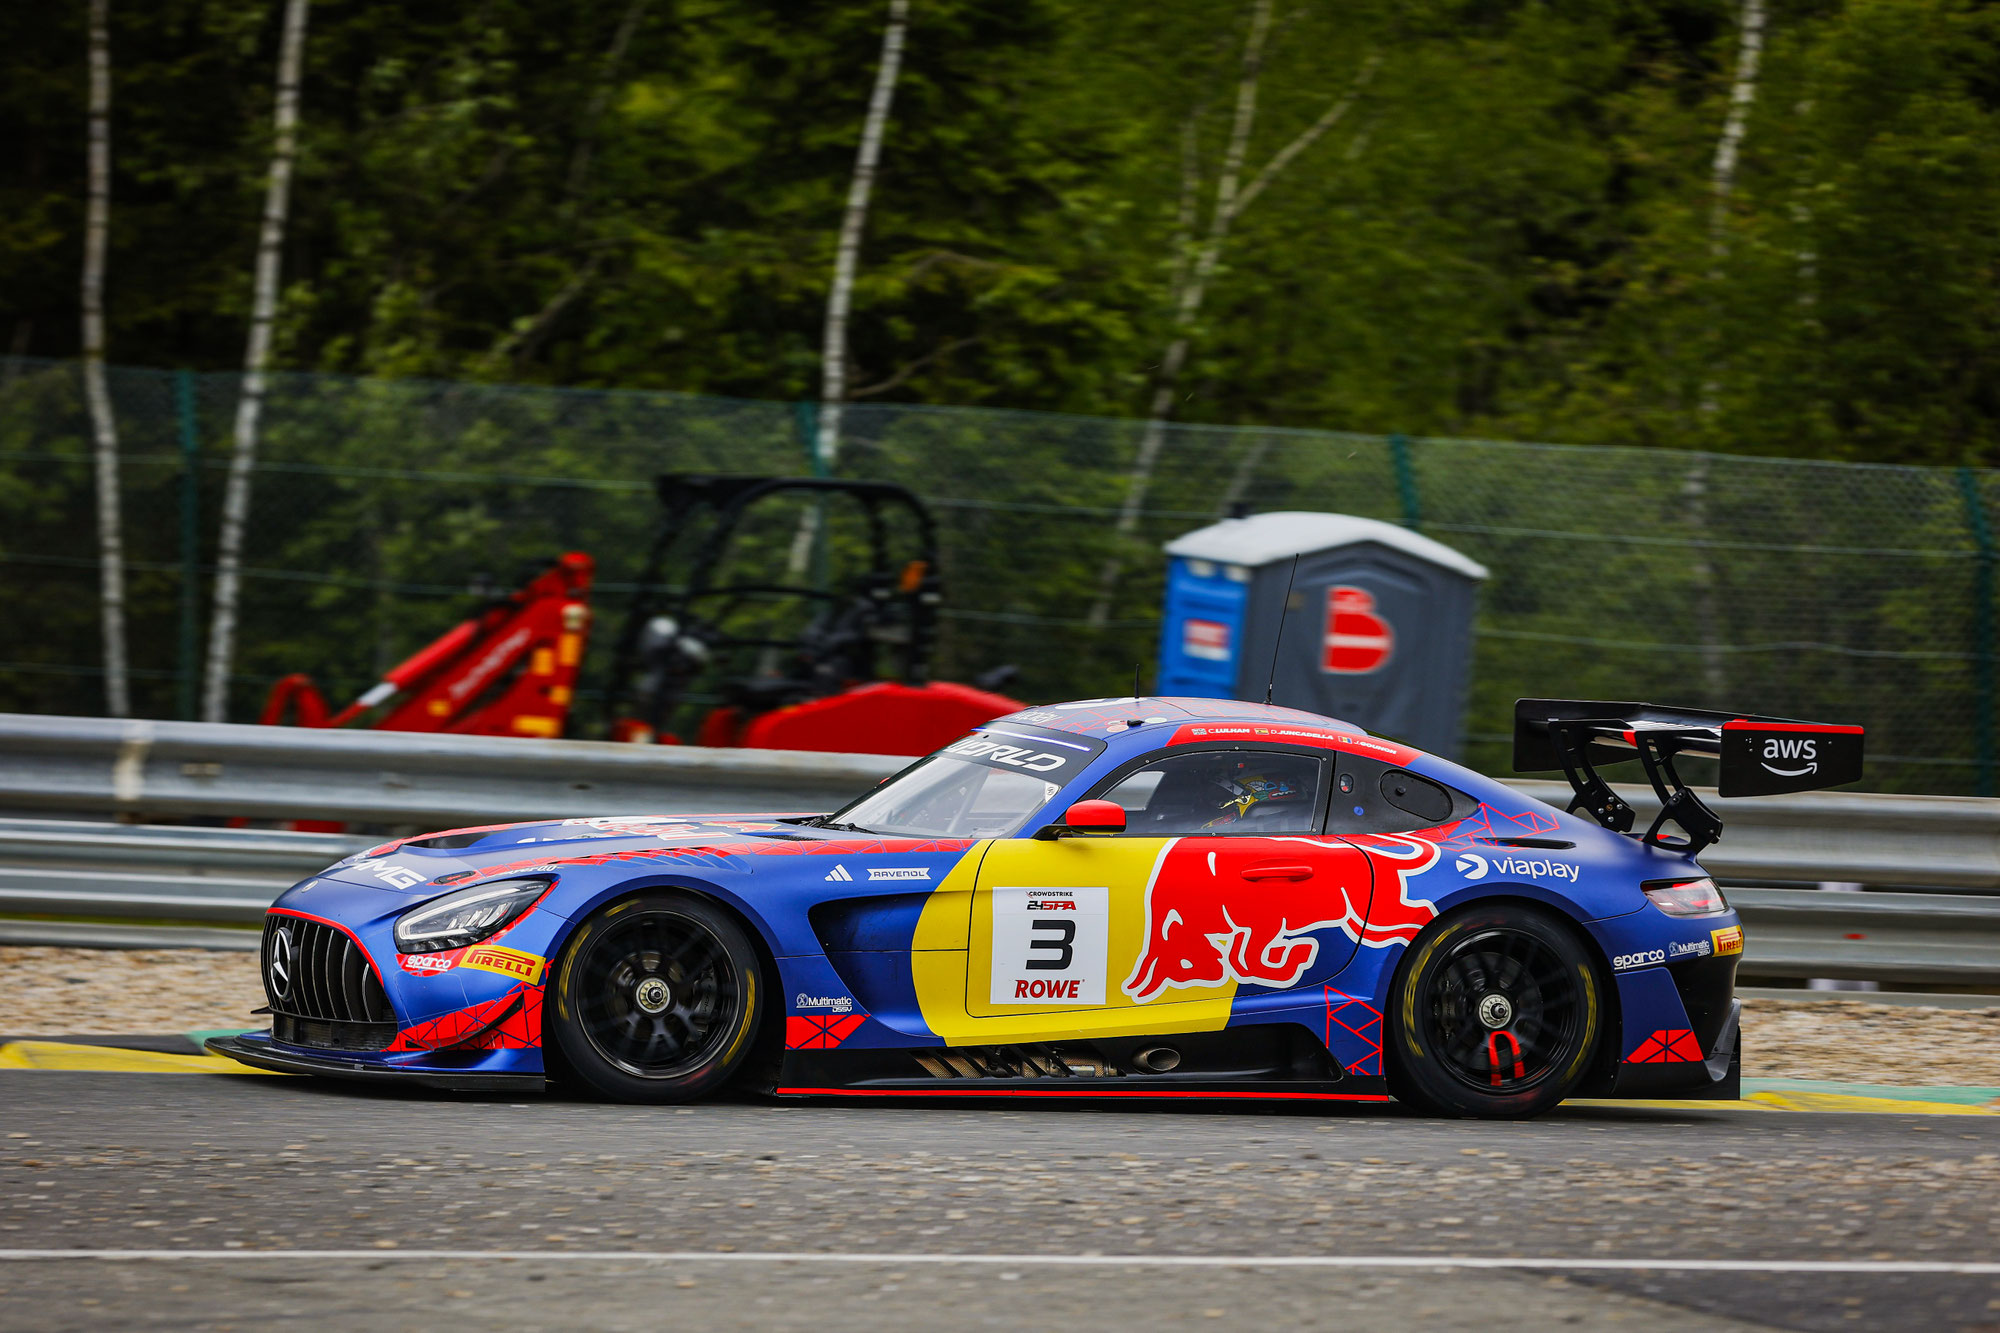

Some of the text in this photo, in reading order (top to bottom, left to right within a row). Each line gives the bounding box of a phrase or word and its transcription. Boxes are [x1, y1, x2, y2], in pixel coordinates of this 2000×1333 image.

[1763, 738, 1817, 760] aws
[873, 870, 925, 878] RAVENOL
[1492, 857, 1580, 882] viaplay
[1025, 919, 1076, 970] 3
[407, 955, 452, 969] sparco
[467, 949, 536, 977] PIRELLI
[1613, 949, 1665, 969] sparco
[1015, 979, 1081, 999] ROWE
[808, 996, 852, 1006] Multimatic
